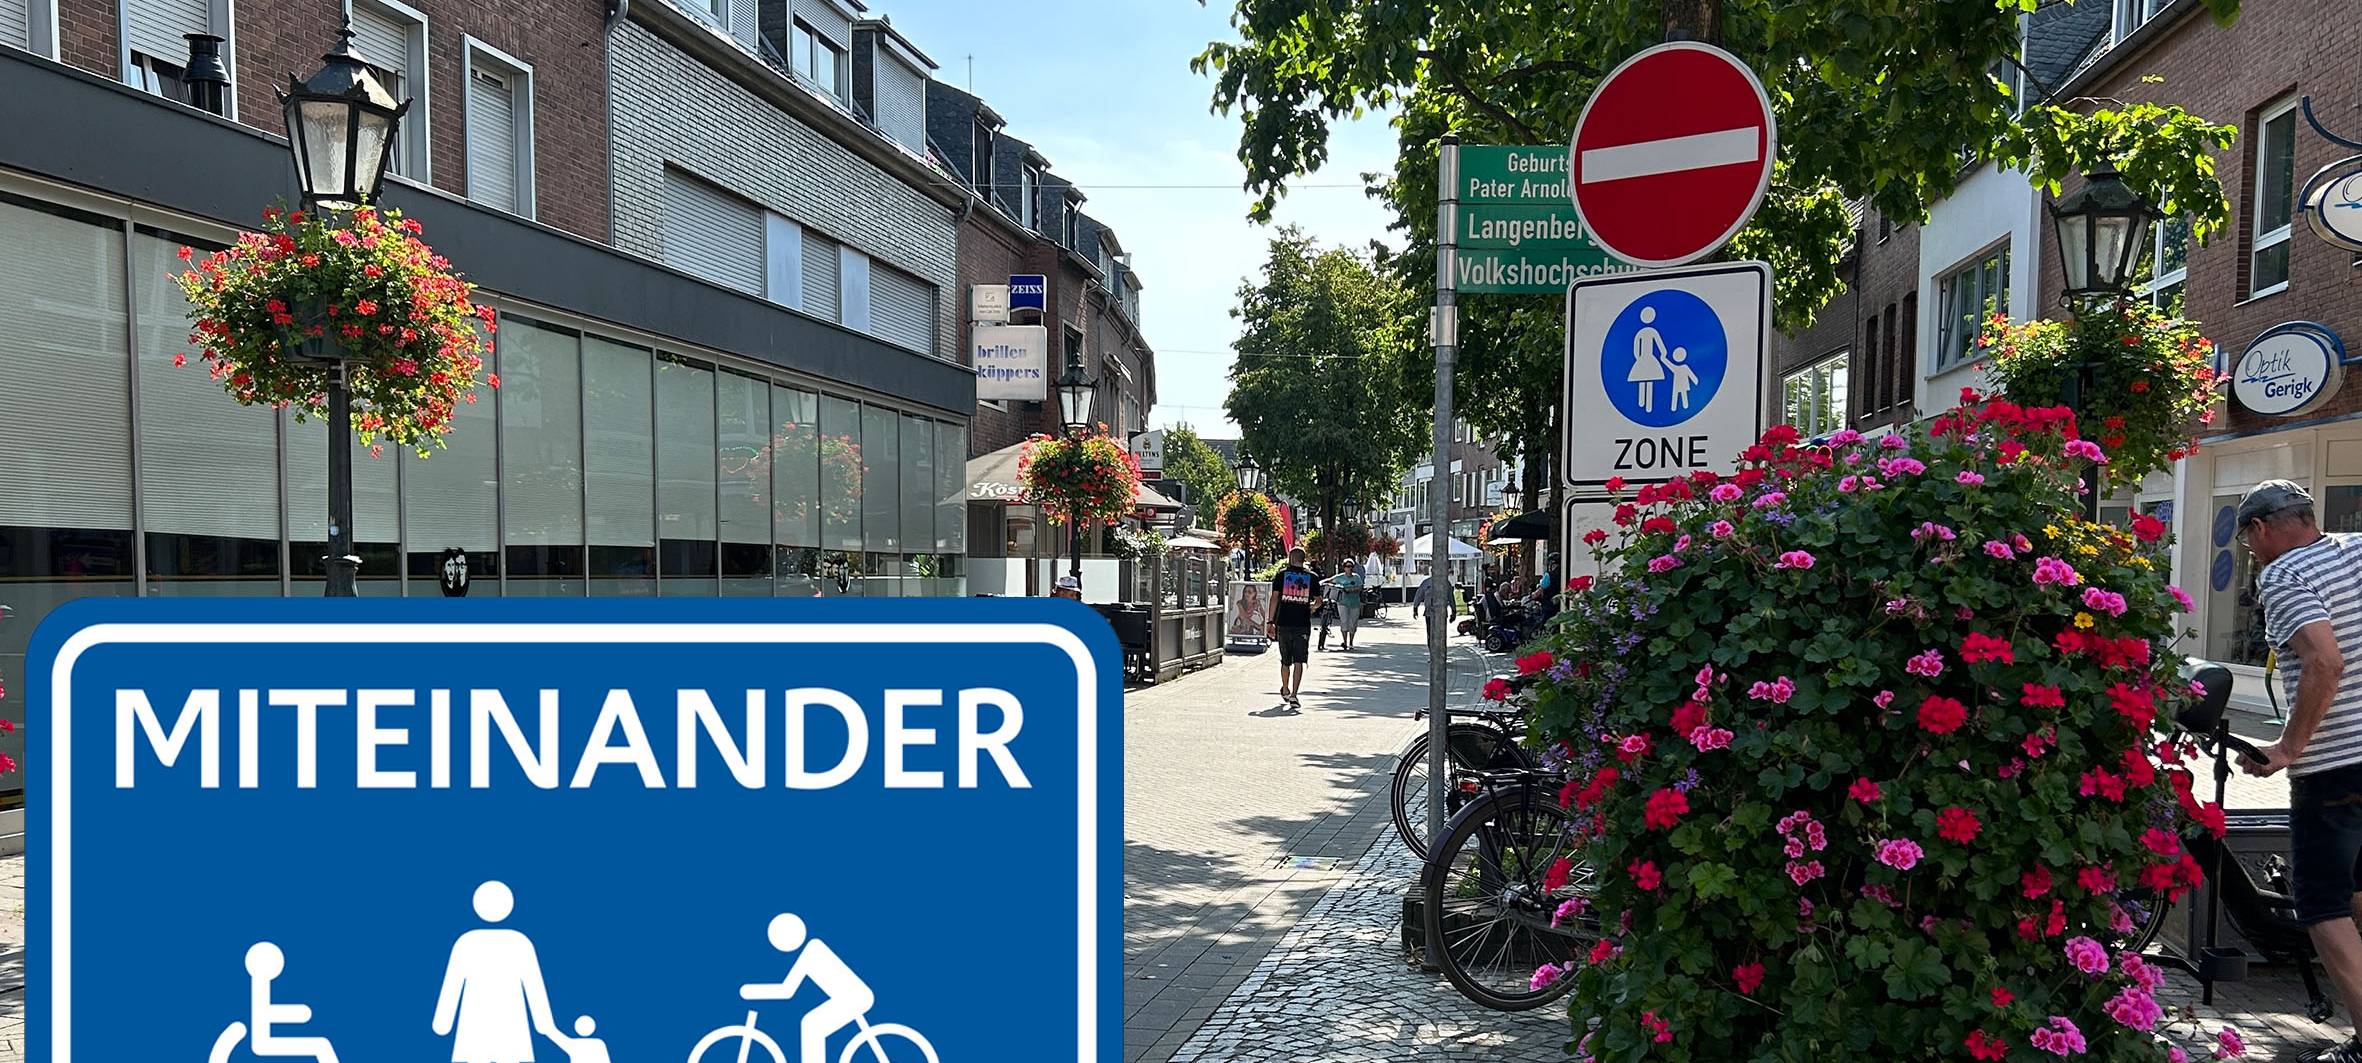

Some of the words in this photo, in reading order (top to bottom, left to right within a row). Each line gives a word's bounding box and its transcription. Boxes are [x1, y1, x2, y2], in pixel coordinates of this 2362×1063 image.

[1470, 178, 1515, 198] Pater
[1468, 213, 1599, 246] Langenber
[1011, 284, 1043, 294] ZEISS
[977, 344, 1027, 359] brillen
[976, 364, 1040, 382] küppers
[2245, 348, 2291, 378] Optik
[2264, 377, 2313, 399] Gerigk
[1613, 435, 1709, 470] ZONE
